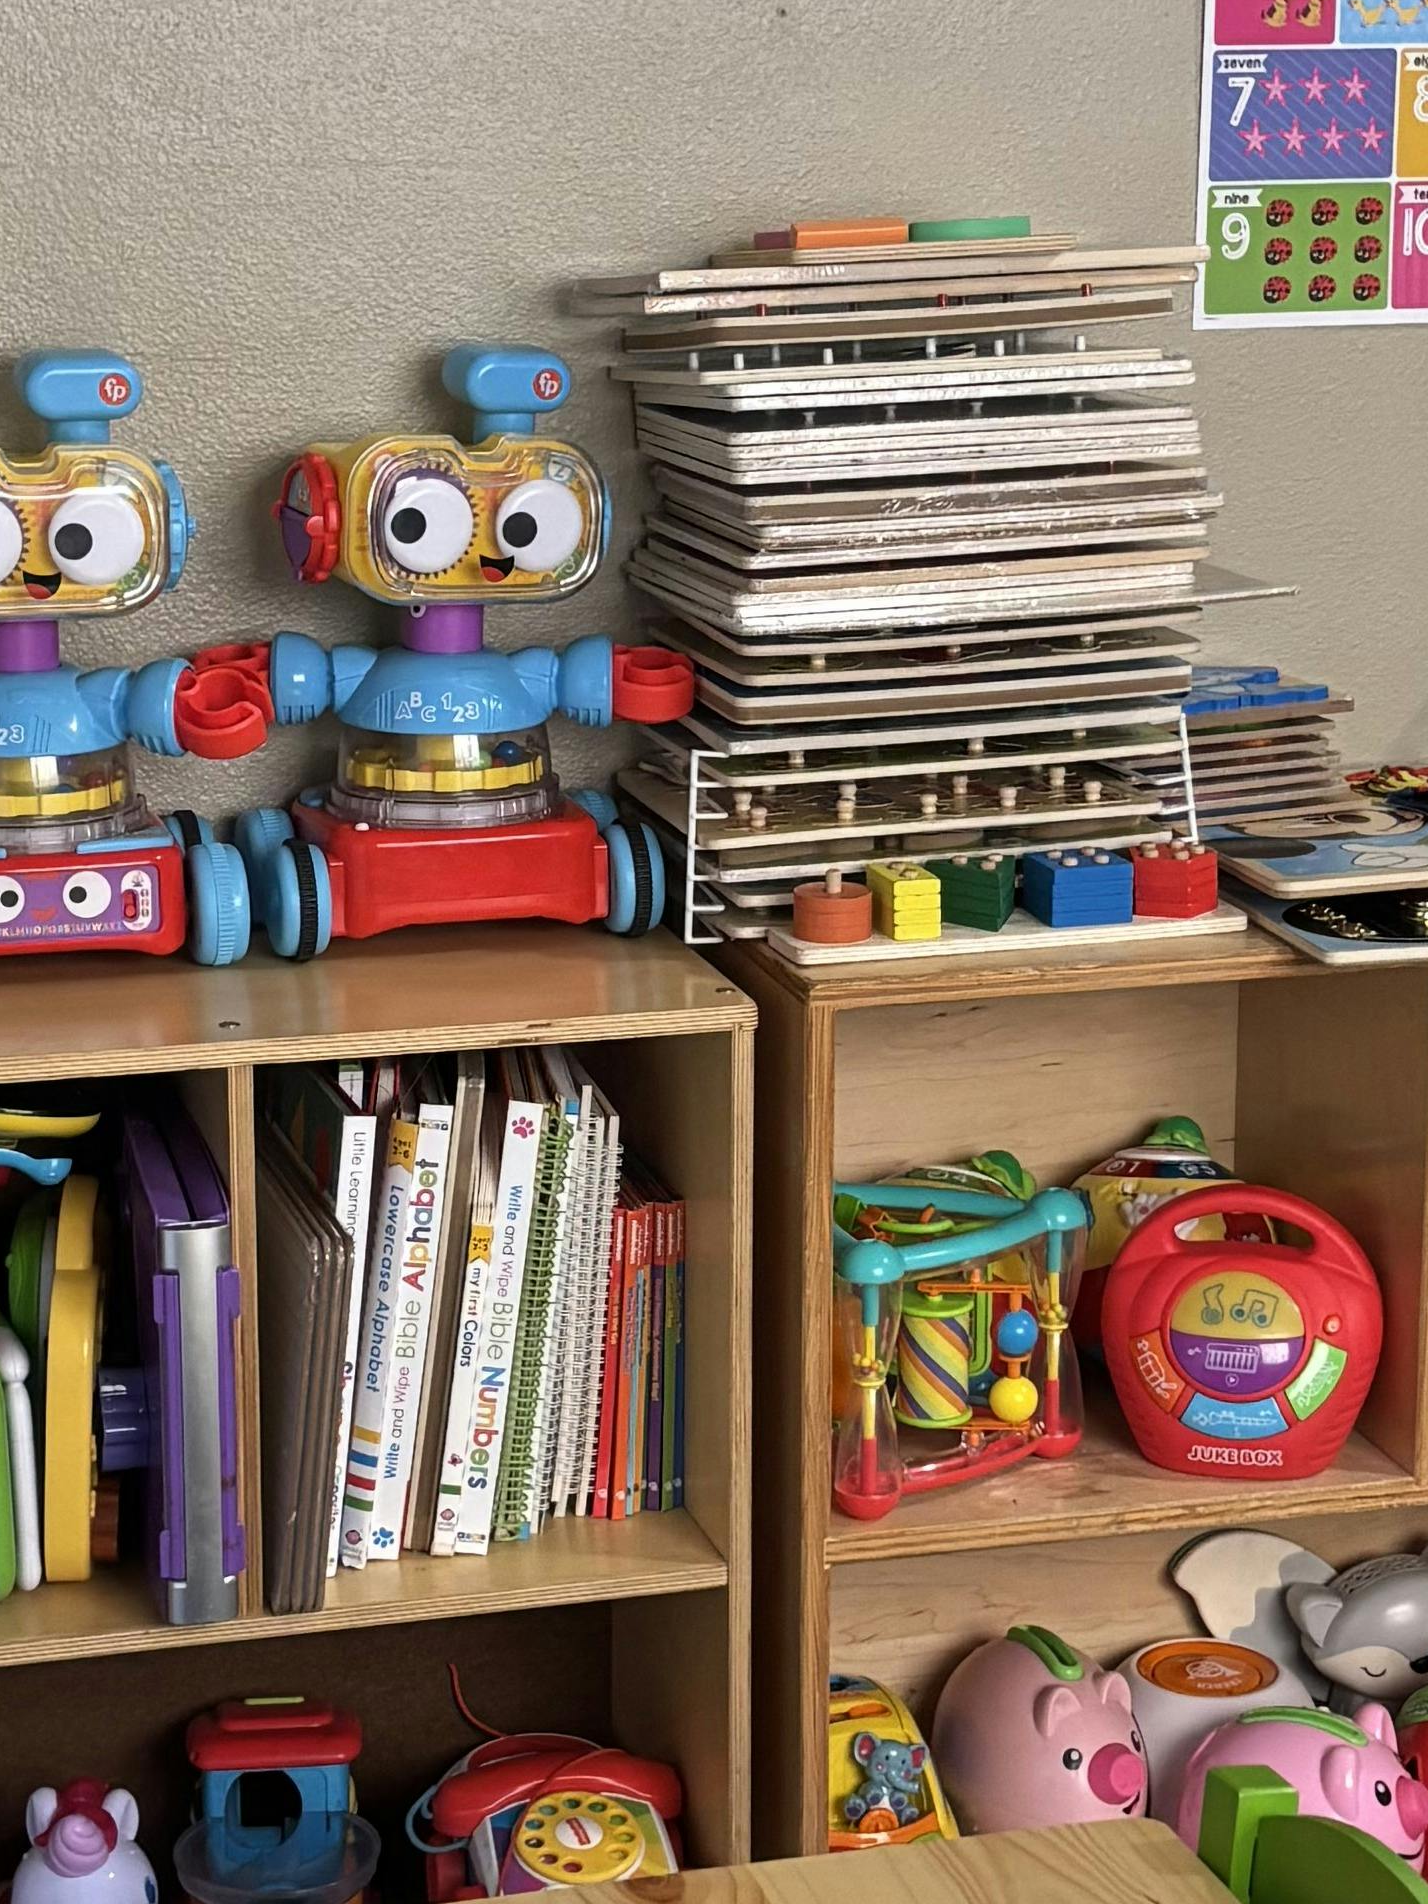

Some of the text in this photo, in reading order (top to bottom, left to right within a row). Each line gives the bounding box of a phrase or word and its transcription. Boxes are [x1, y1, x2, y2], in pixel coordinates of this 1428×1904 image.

[1224, 57, 1262, 69] seven
[1228, 77, 1255, 126] 7
[1224, 192, 1249, 205] nine
[1221, 212, 1250, 260] 9
[105, 377, 127, 401] fp
[538, 372, 559, 396] fp
[351, 1132, 367, 1166] Little
[378, 1185, 404, 1293] Lowercase
[402, 1158, 439, 1292] Alphabet
[468, 1266, 481, 1292] my
[464, 1290, 480, 1321] first
[365, 1299, 390, 1393] Alphabet
[394, 1298, 422, 1360] Bible
[460, 1320, 478, 1368] Colors
[468, 1184, 523, 1489] Write and Wipe Bible Numbers
[393, 1366, 410, 1404] Wipe
[393, 1408, 404, 1438] and
[384, 1443, 401, 1479] Write
[1187, 1445, 1283, 1466] JUKE BOX
